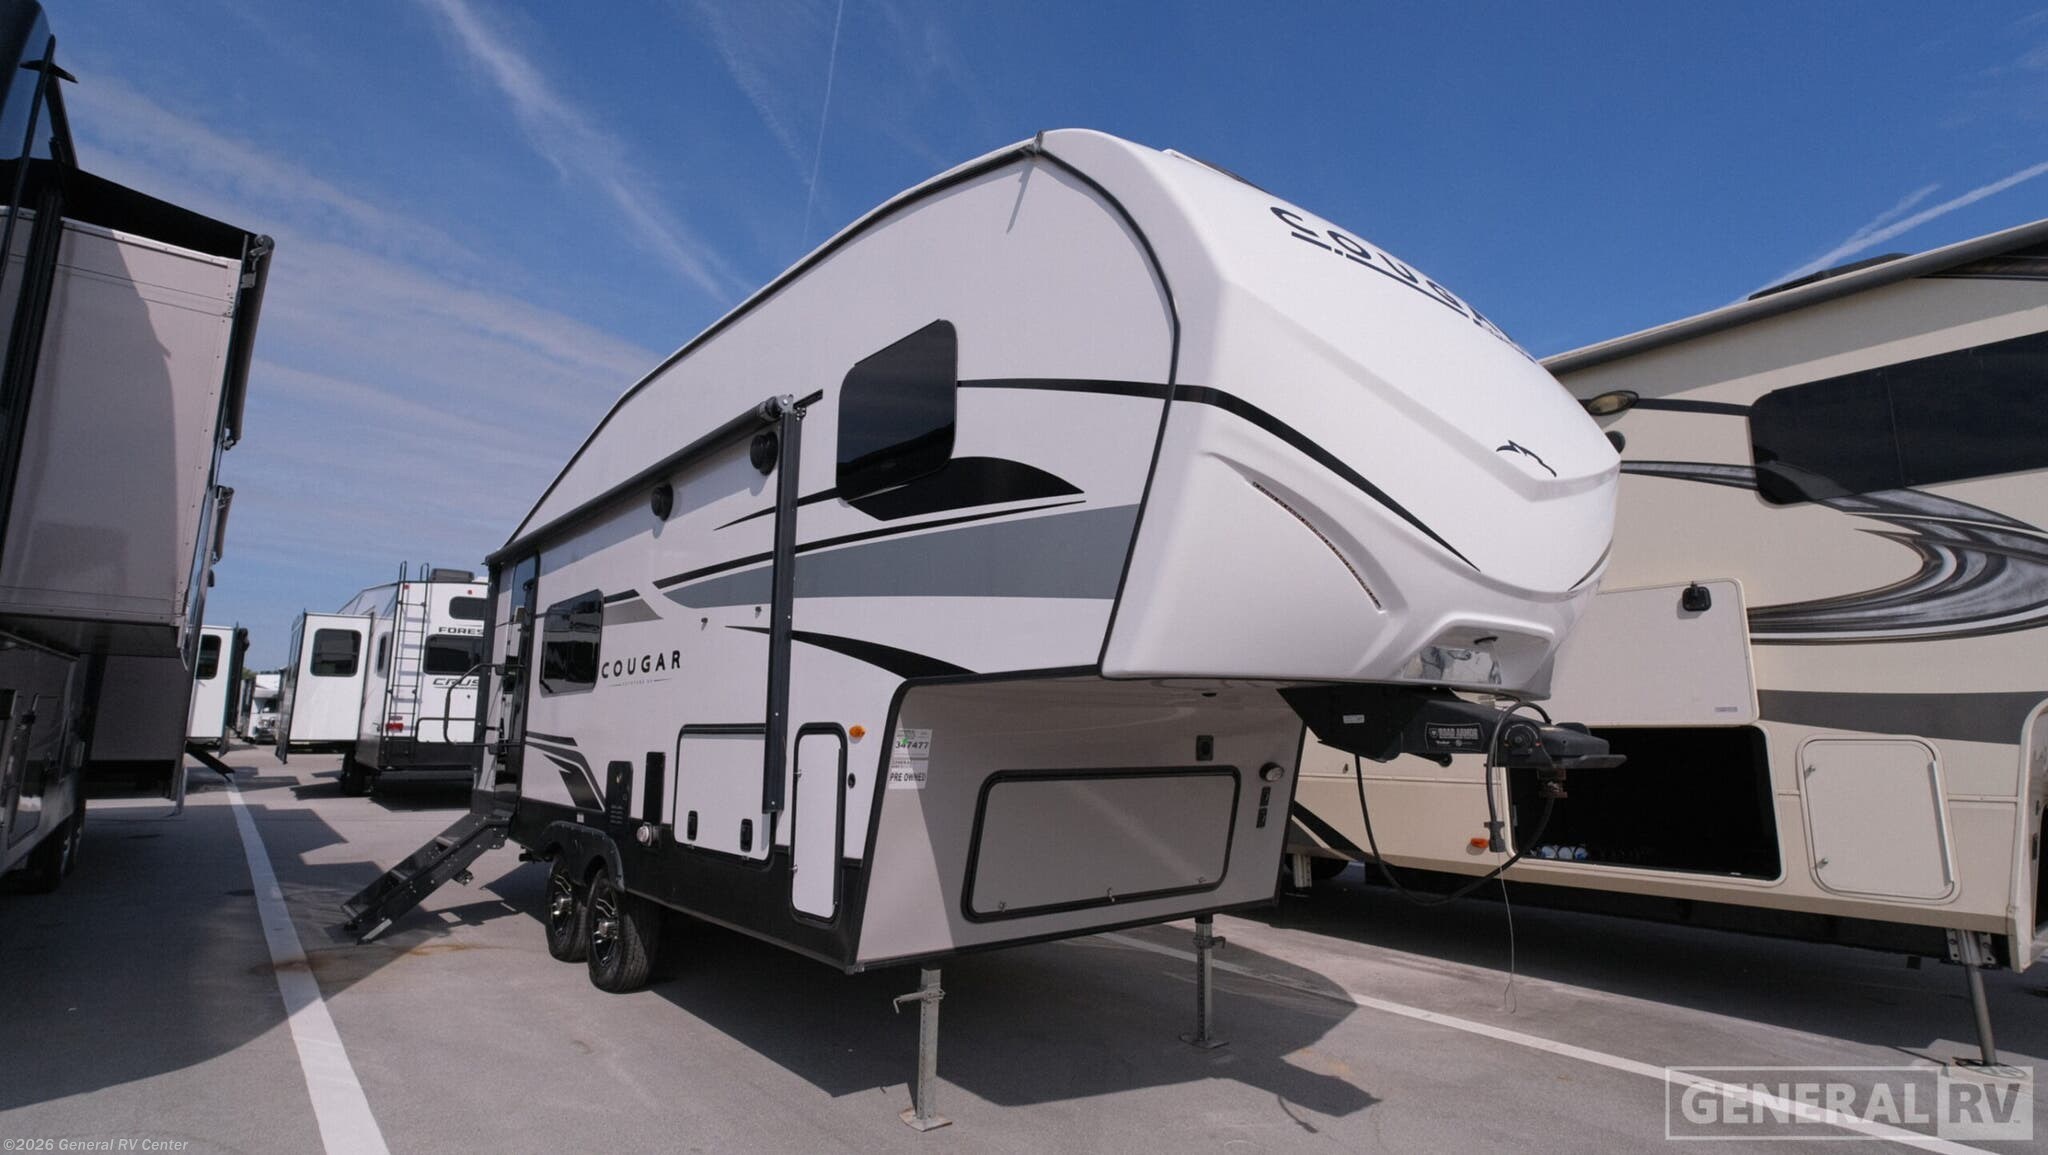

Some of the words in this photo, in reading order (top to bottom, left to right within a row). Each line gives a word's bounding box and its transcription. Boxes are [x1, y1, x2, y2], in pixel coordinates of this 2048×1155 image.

[1270, 206, 1513, 345] COUG
[438, 627, 484, 635] FORES
[601, 650, 681, 679] COUGAR
[433, 678, 479, 687] CRUS
[890, 772, 902, 782] PRE
[903, 772, 926, 782] OWNED
